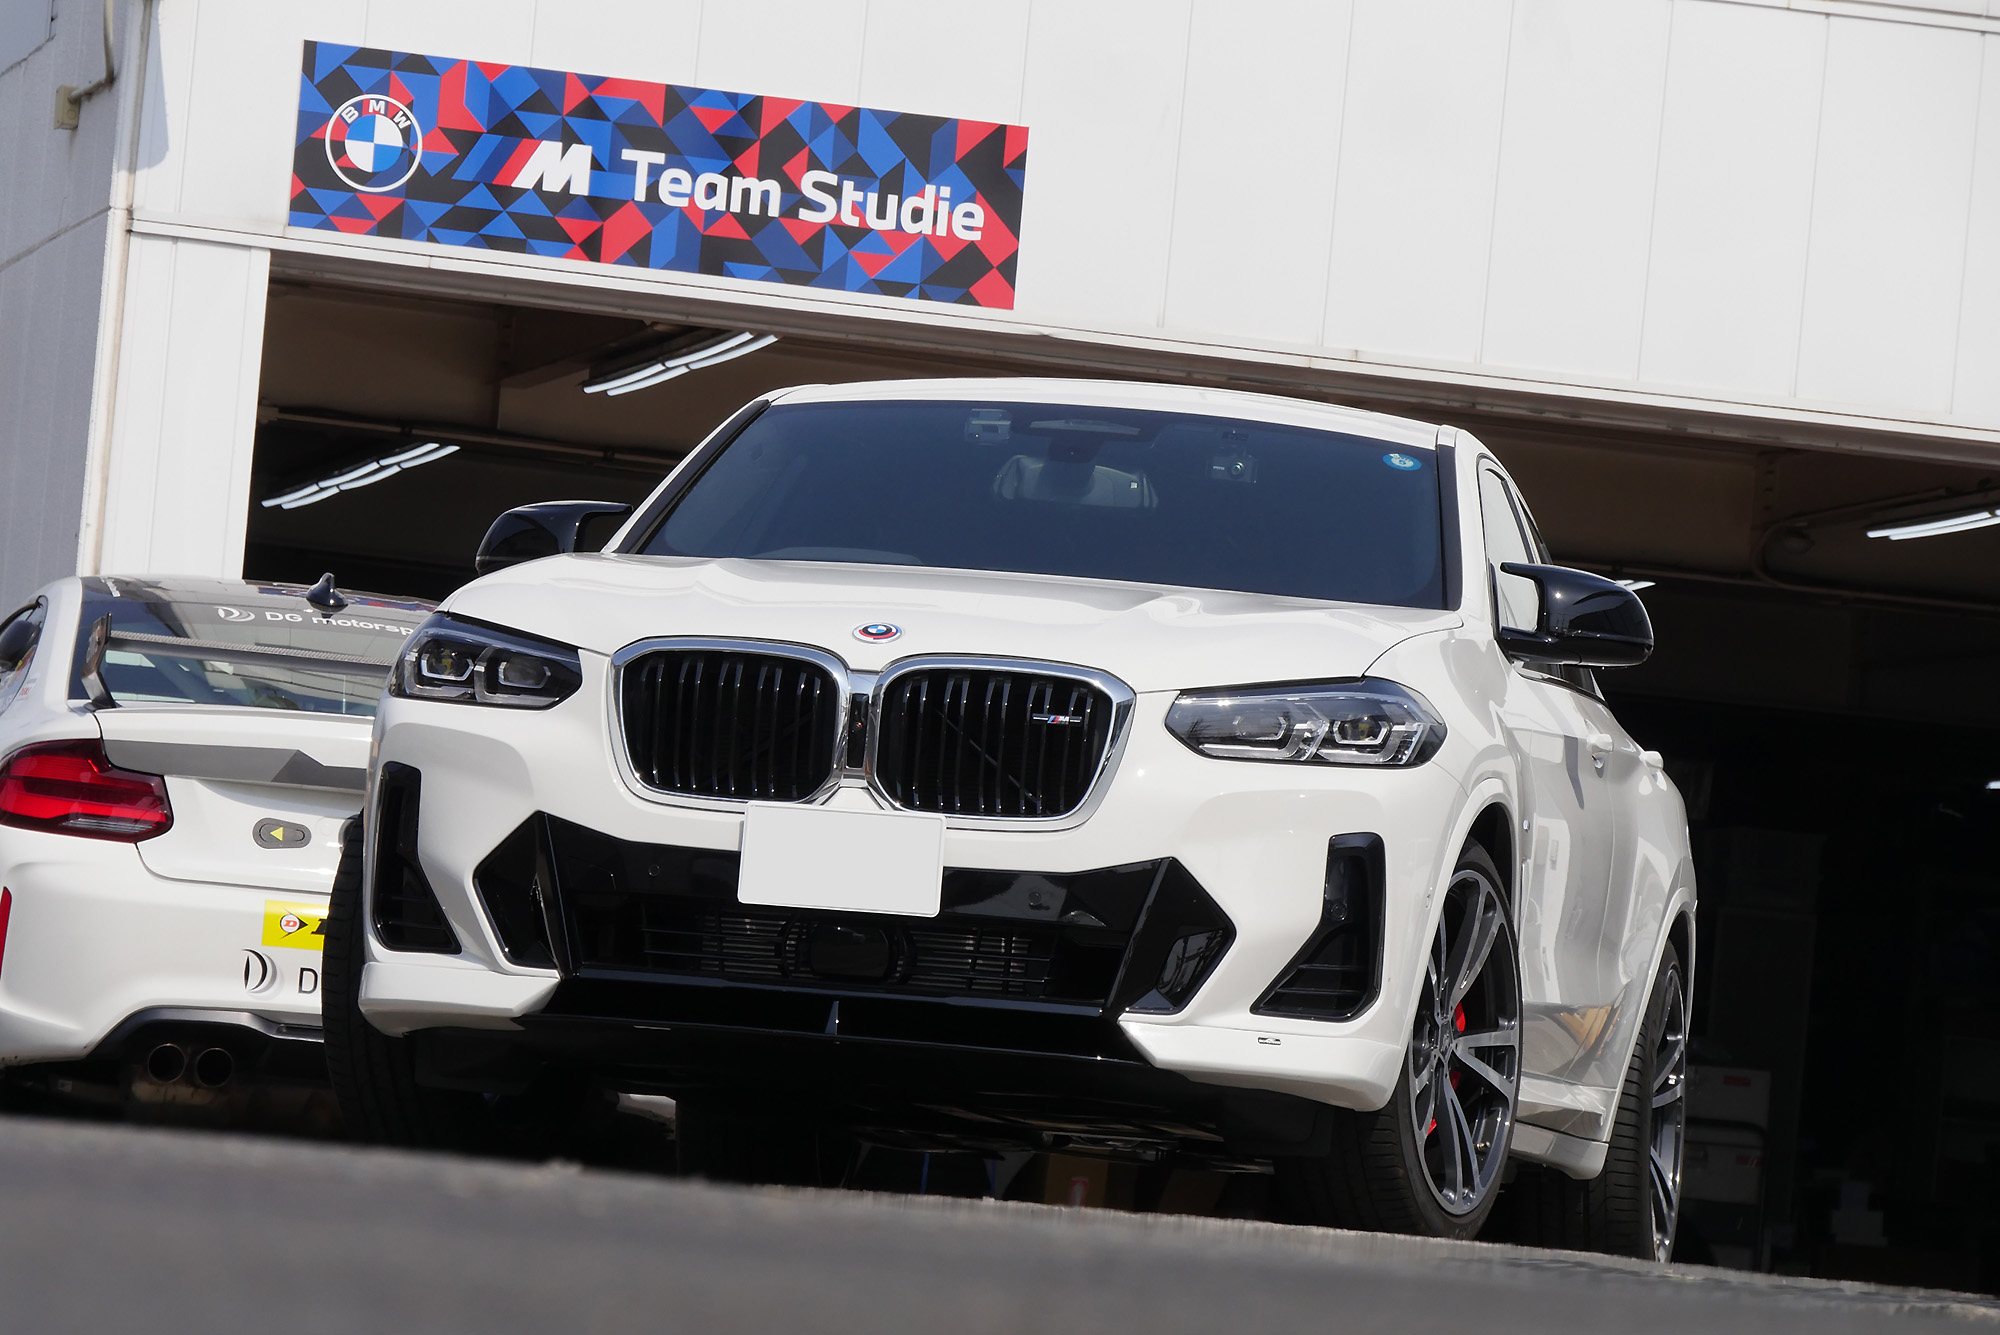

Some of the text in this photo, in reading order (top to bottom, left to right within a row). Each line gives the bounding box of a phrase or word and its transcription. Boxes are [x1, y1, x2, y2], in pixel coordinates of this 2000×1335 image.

[340, 99, 412, 129] BMW
[621, 148, 782, 218] Team
[799, 169, 984, 241] Studie
[264, 611, 303, 622] DG
